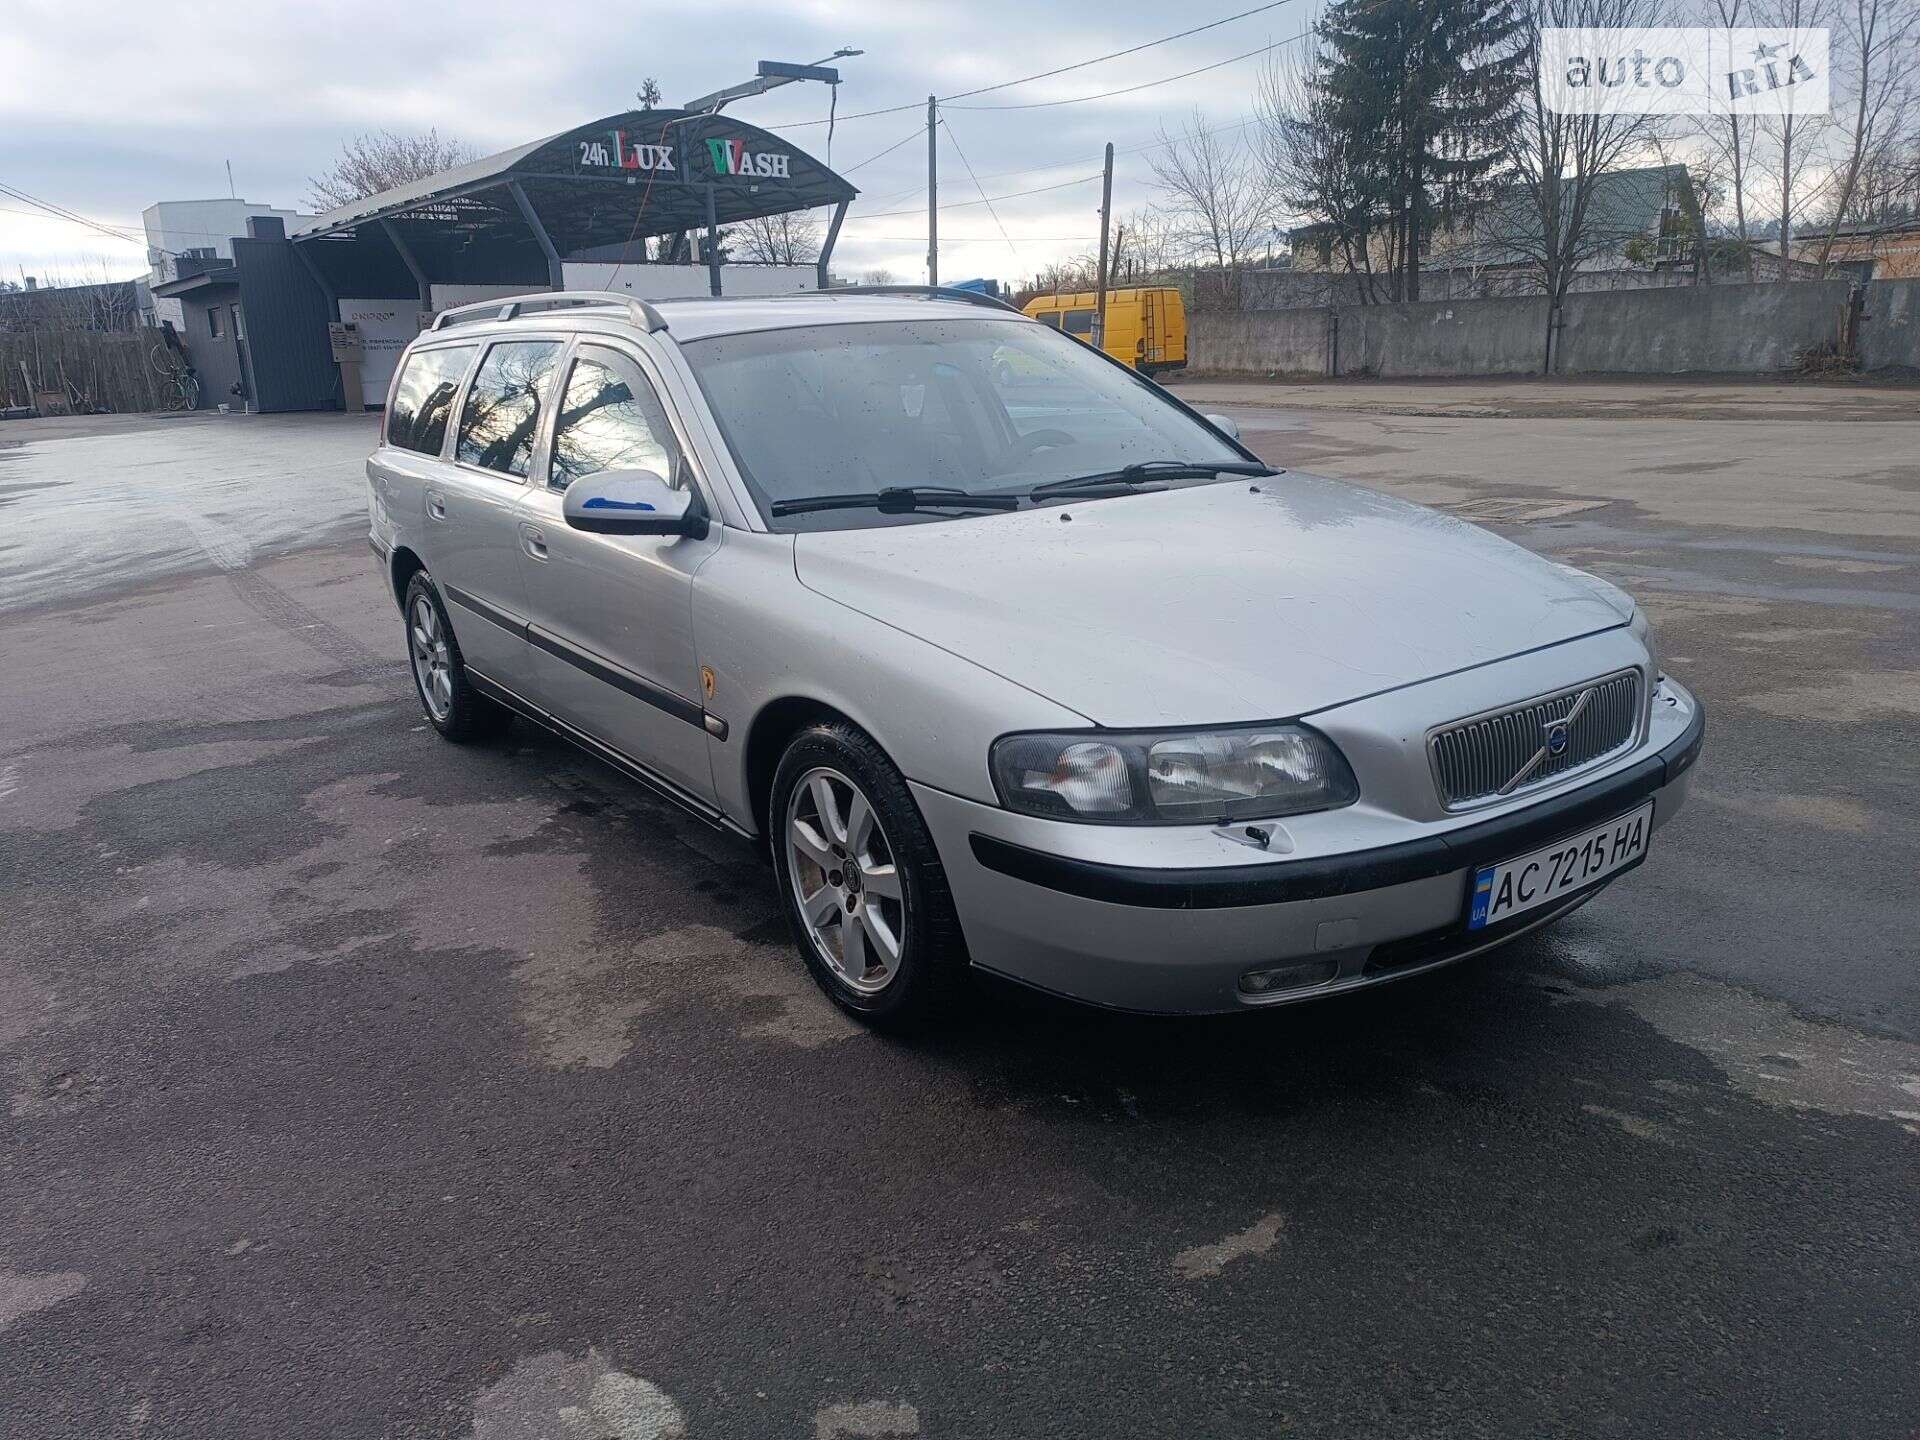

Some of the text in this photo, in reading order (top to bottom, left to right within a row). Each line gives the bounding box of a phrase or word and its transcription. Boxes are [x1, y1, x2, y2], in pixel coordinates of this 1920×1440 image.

[580, 129, 791, 179] 24h LUX WASH
[1491, 816, 1643, 915] AC 7215 HA
[1472, 910, 1487, 921] UA
